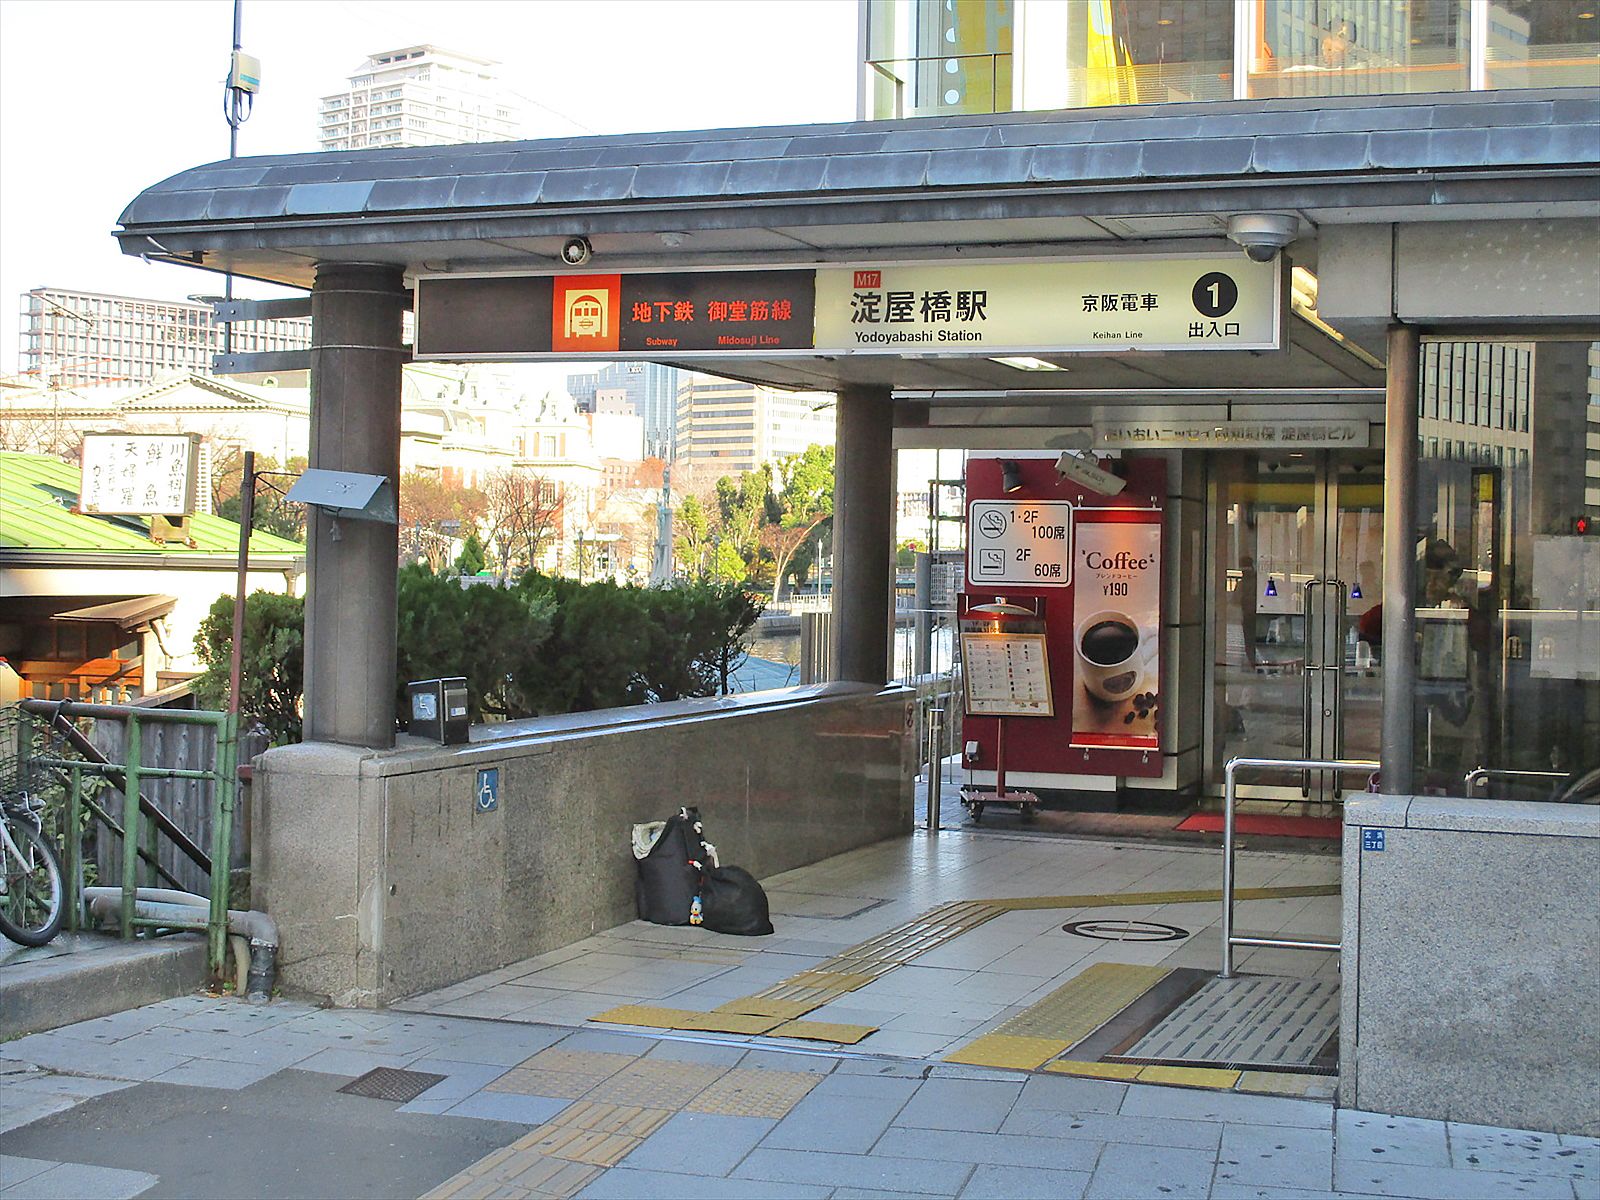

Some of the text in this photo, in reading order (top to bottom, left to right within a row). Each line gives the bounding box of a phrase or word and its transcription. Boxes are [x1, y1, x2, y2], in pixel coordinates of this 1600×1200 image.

[856, 272, 879, 286] M17
[1081, 292, 1159, 313] 京阪電車
[1206, 282, 1220, 308] 1
[631, 300, 792, 323] 地下鉄 御堂筋線
[850, 290, 988, 324] 淀屋橋駅
[854, 329, 983, 345] Yodoyabashi Station
[1092, 330, 1143, 340] Keihan Line
[1188, 321, 1241, 339] 出入口
[646, 335, 780, 348] Subway Midosuji Line
[142, 442, 164, 507] 鮮魚
[167, 442, 185, 507] 川魚料理
[1032, 526, 1065, 540] 100席
[1016, 548, 1031, 561] 2F
[1086, 551, 1148, 570] Coffee
[1034, 564, 1061, 577] 60席
[1103, 582, 1128, 596] ¥190
